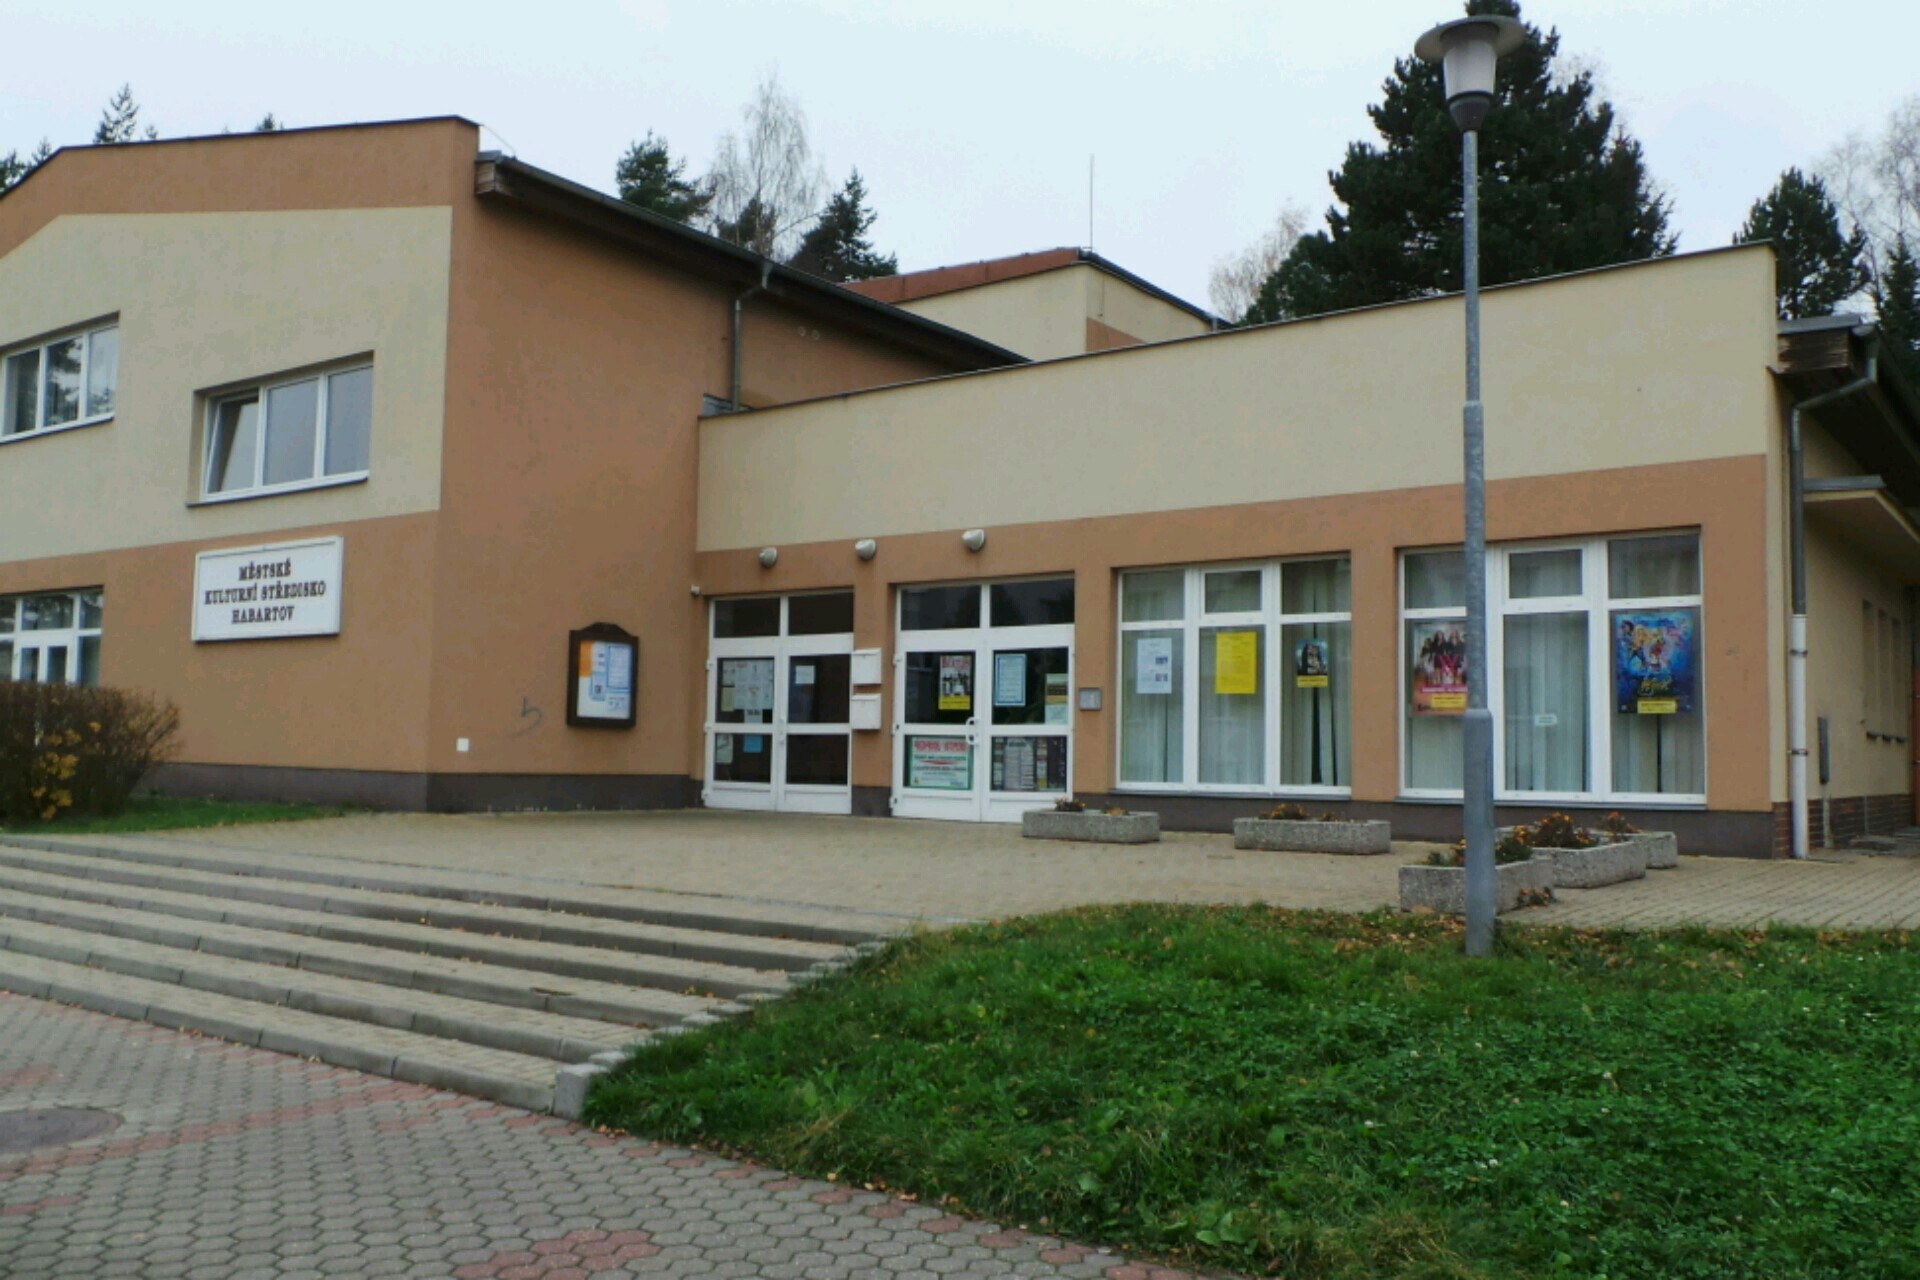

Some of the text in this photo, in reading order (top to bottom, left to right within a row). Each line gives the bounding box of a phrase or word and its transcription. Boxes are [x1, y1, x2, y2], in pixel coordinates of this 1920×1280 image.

[238, 557, 292, 581] MĚSTSKÉ
[204, 580, 327, 605] KULTURNÍ STŘEDISKO
[231, 605, 295, 624] HABARTOV
